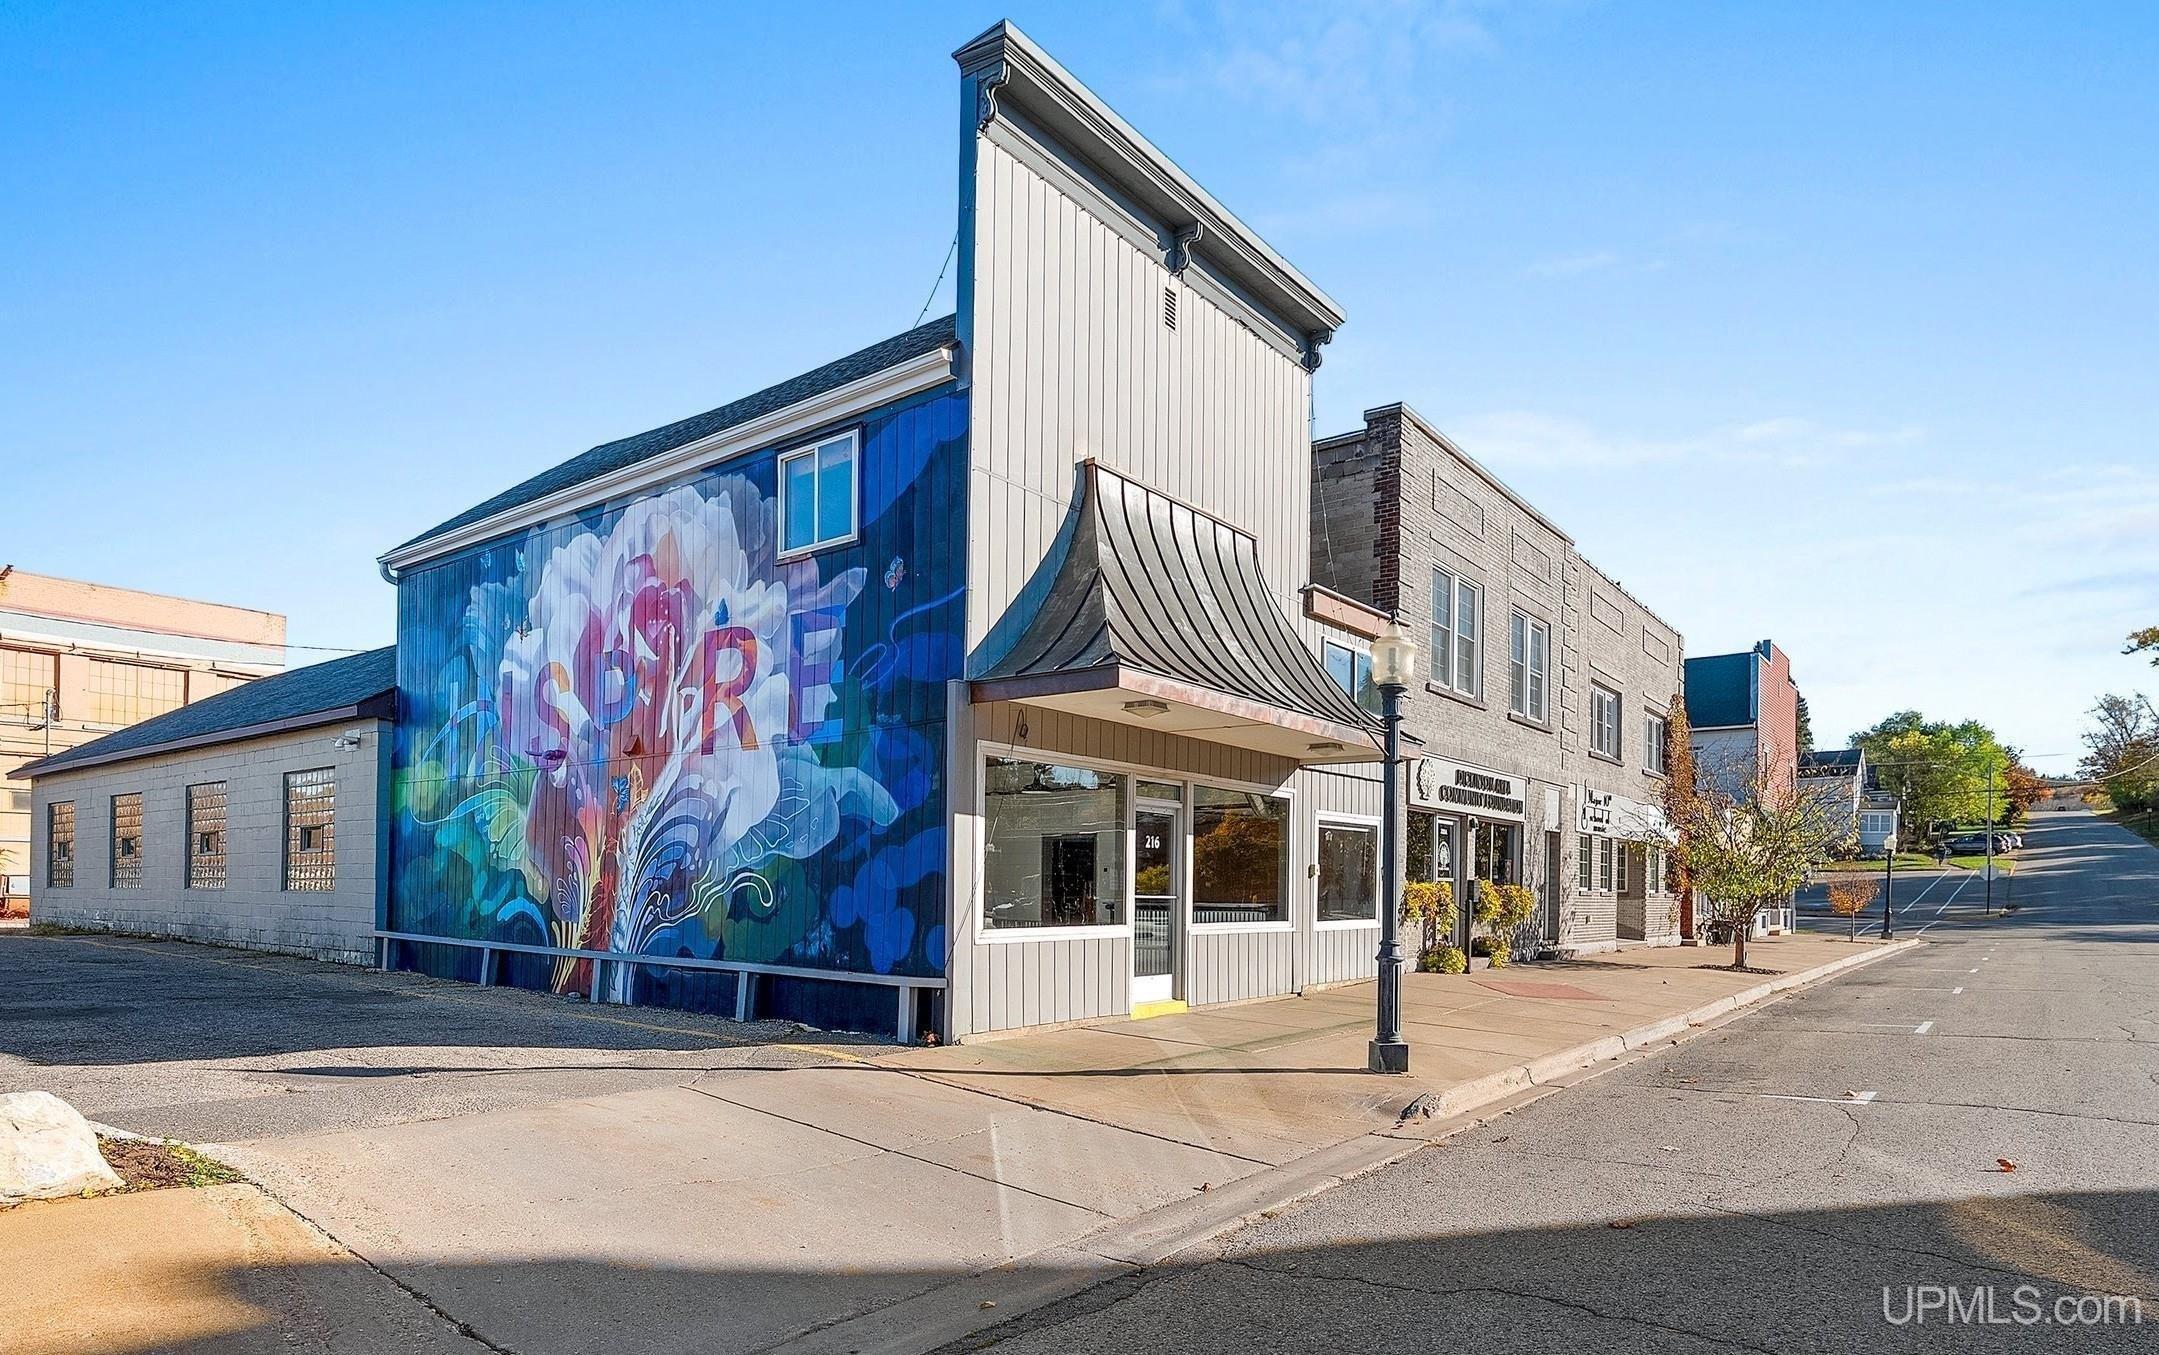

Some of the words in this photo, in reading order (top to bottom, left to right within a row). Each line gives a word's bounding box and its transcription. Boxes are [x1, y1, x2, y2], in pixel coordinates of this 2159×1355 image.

[1438, 784, 1484, 808] COMMUNITY
[1483, 794, 1524, 815] FOUNDATION
[1145, 834, 1161, 849] 216
